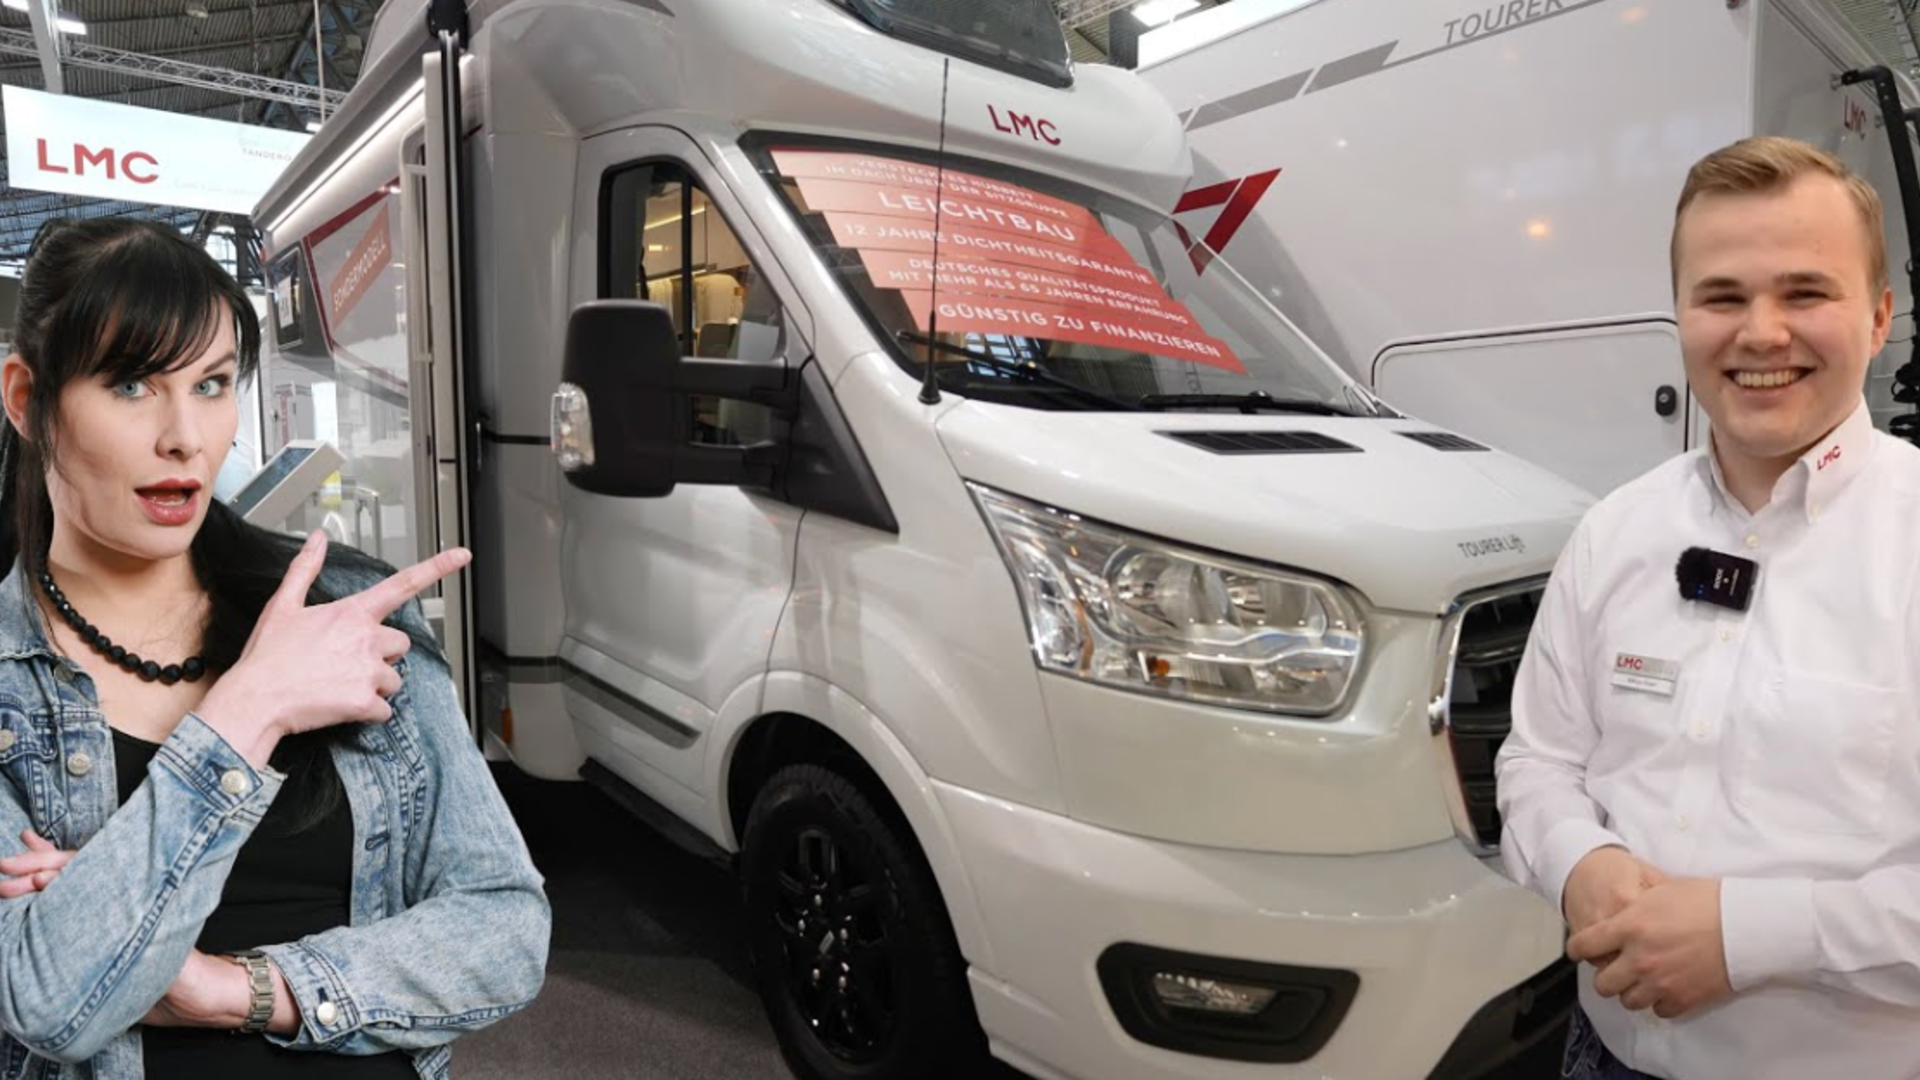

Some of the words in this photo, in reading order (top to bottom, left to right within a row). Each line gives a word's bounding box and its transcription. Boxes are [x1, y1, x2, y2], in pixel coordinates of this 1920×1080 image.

[986, 103, 1062, 147] LMC
[1844, 95, 1867, 140] LMC
[36, 137, 159, 184] LMC
[241, 147, 292, 162] TANDERO
[825, 162, 846, 175] IM
[851, 167, 898, 181] DACH
[949, 181, 980, 196] DER
[984, 189, 1070, 219] SITZGRUPPE
[857, 159, 968, 184] VERSTECKTES
[970, 179, 1034, 200] HUBBETT
[877, 189, 1076, 242] LEICHTBAU
[333, 230, 387, 313] SONDERMODELL
[844, 223, 868, 236] 12
[877, 227, 948, 244] JAHRE
[952, 233, 1153, 285] DICHTHEITSGARANTIE
[888, 269, 921, 282] MIT
[927, 272, 978, 287] MEHR
[983, 277, 1016, 291] ALS
[1019, 282, 1041, 295] 65
[1045, 285, 1105, 306] JAHREN
[1107, 297, 1189, 325] ERFAHRUNG
[908, 258, 1012, 279] DEUTSCHES
[1015, 270, 1161, 309] QUALITÄTSPRODUKT
[938, 301, 1049, 327] GÜNSTIG
[1053, 314, 1085, 331] ZU
[1089, 319, 1222, 359] FINANZIEREN
[1816, 445, 1842, 472] LMC
[1457, 537, 1506, 558] TOURER
[1616, 655, 1643, 671] LMC
